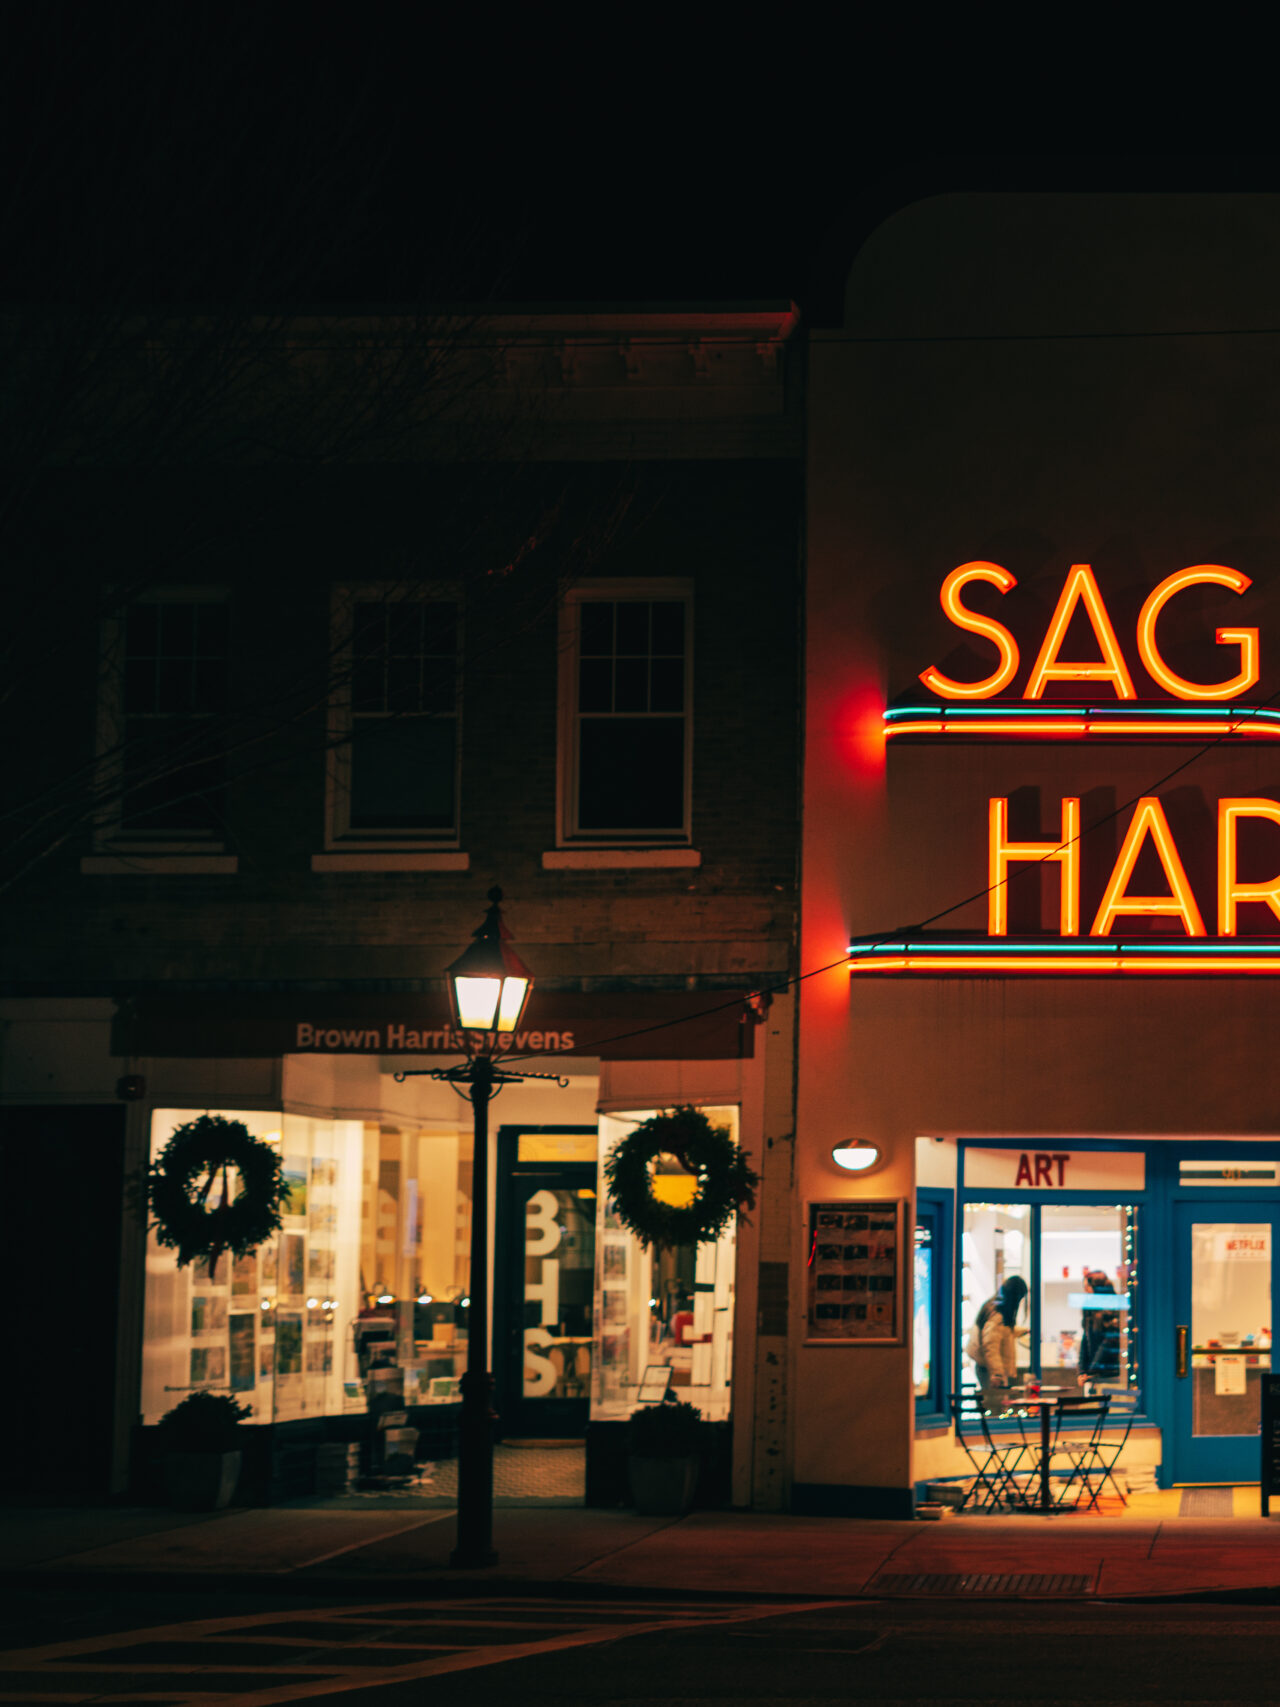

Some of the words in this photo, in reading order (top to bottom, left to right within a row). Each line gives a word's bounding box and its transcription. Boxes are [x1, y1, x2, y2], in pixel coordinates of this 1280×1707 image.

[918, 560, 1261, 701] SAG
[296, 1023, 380, 1048] Brown
[387, 1023, 464, 1049] Harris
[1015, 1153, 1070, 1187] ART
[1225, 1239, 1266, 1251] NETFLIX
